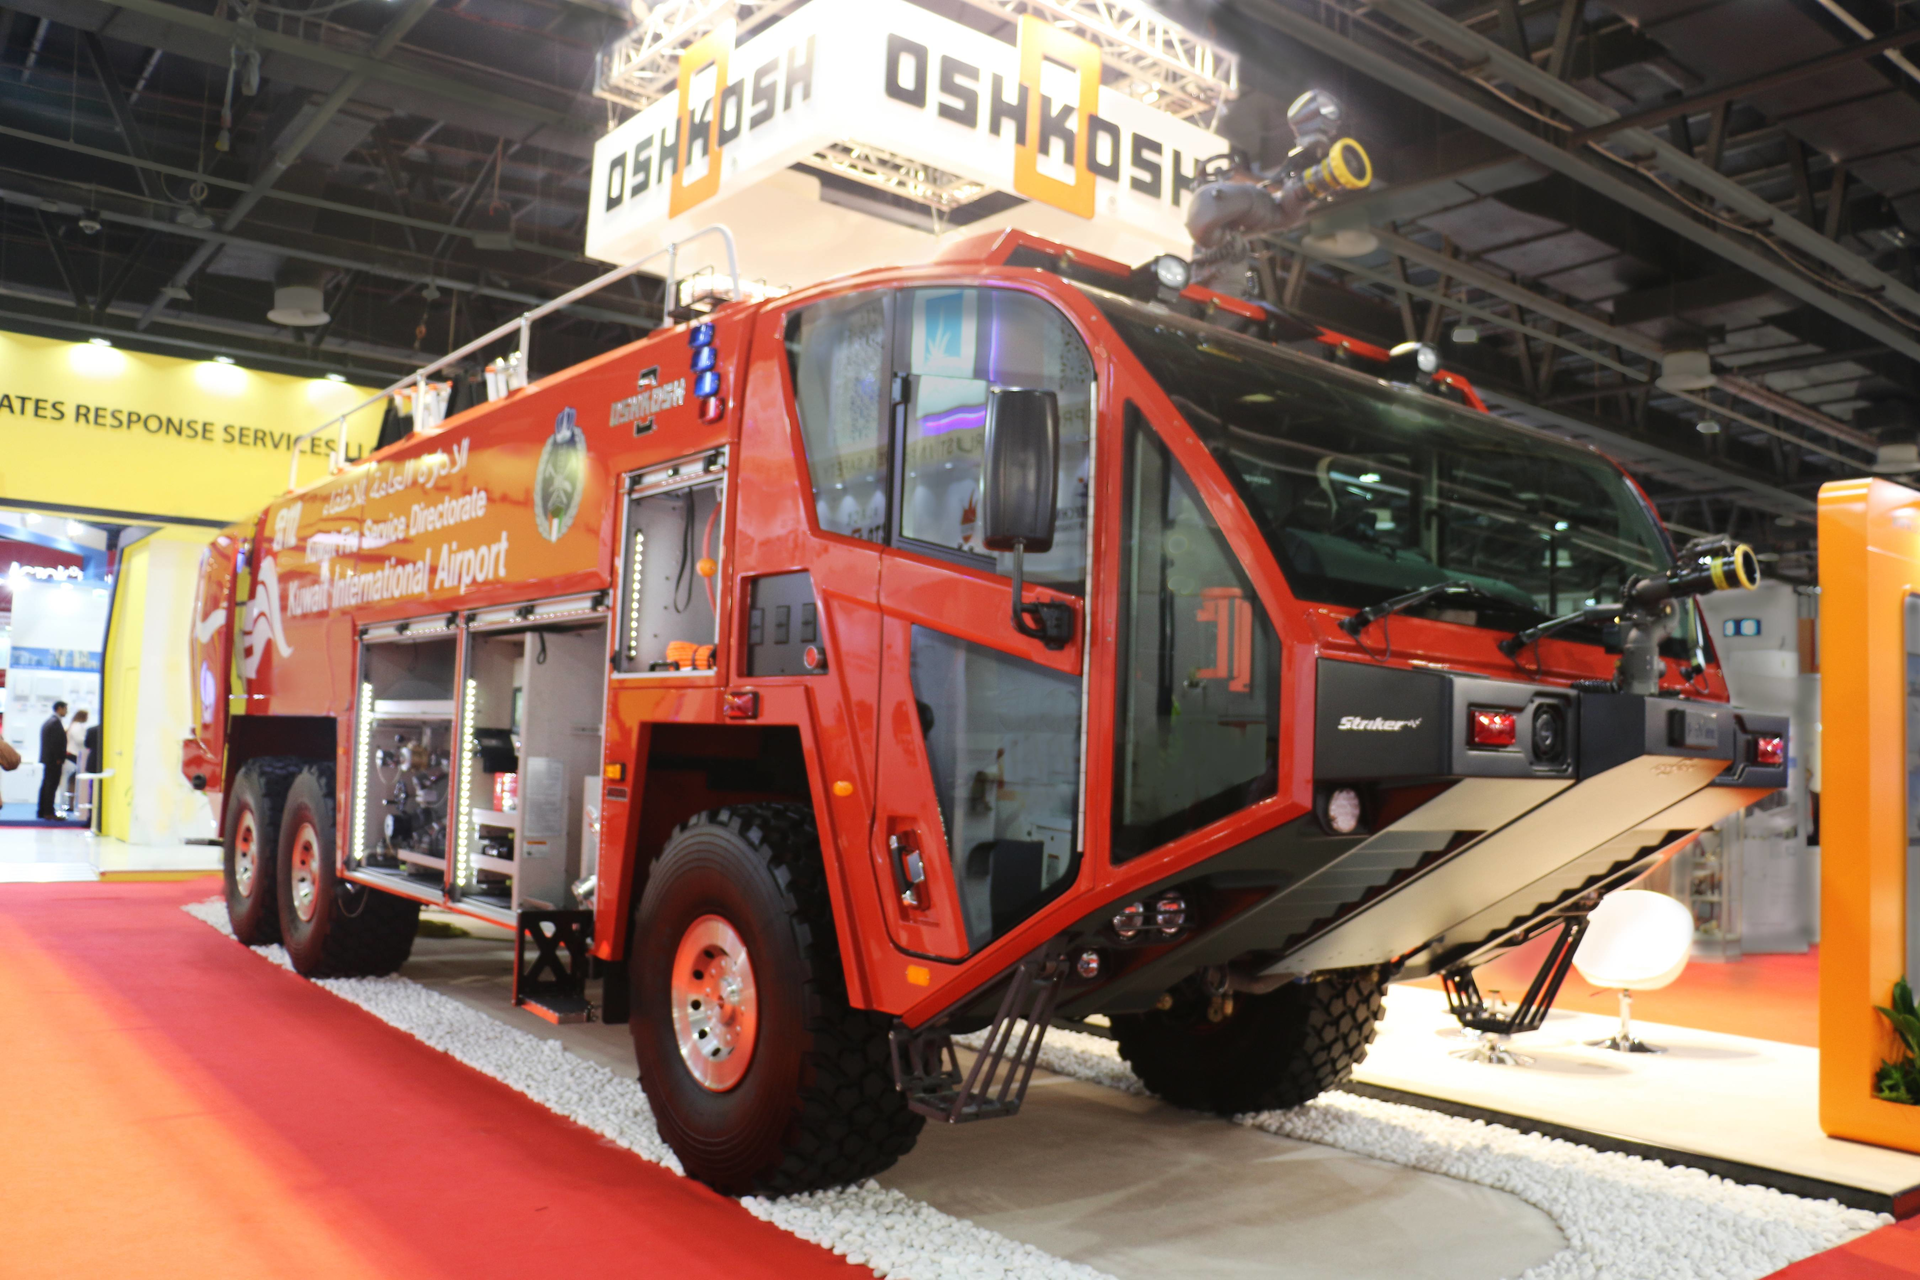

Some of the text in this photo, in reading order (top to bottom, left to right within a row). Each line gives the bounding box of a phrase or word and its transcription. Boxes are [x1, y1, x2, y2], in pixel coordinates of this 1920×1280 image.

[606, 33, 817, 213] OSHKOSH
[885, 32, 1203, 207] OSHKOSH
[0, 394, 65, 421] ATES
[75, 405, 214, 441] RESPONSE
[223, 424, 337, 457] SERVICES
[609, 377, 686, 428] OSHKOSH
[362, 512, 407, 546] Service
[409, 486, 487, 536] Directorate
[287, 531, 509, 617] Kuwait International Airport
[1338, 716, 1404, 732] Striker
